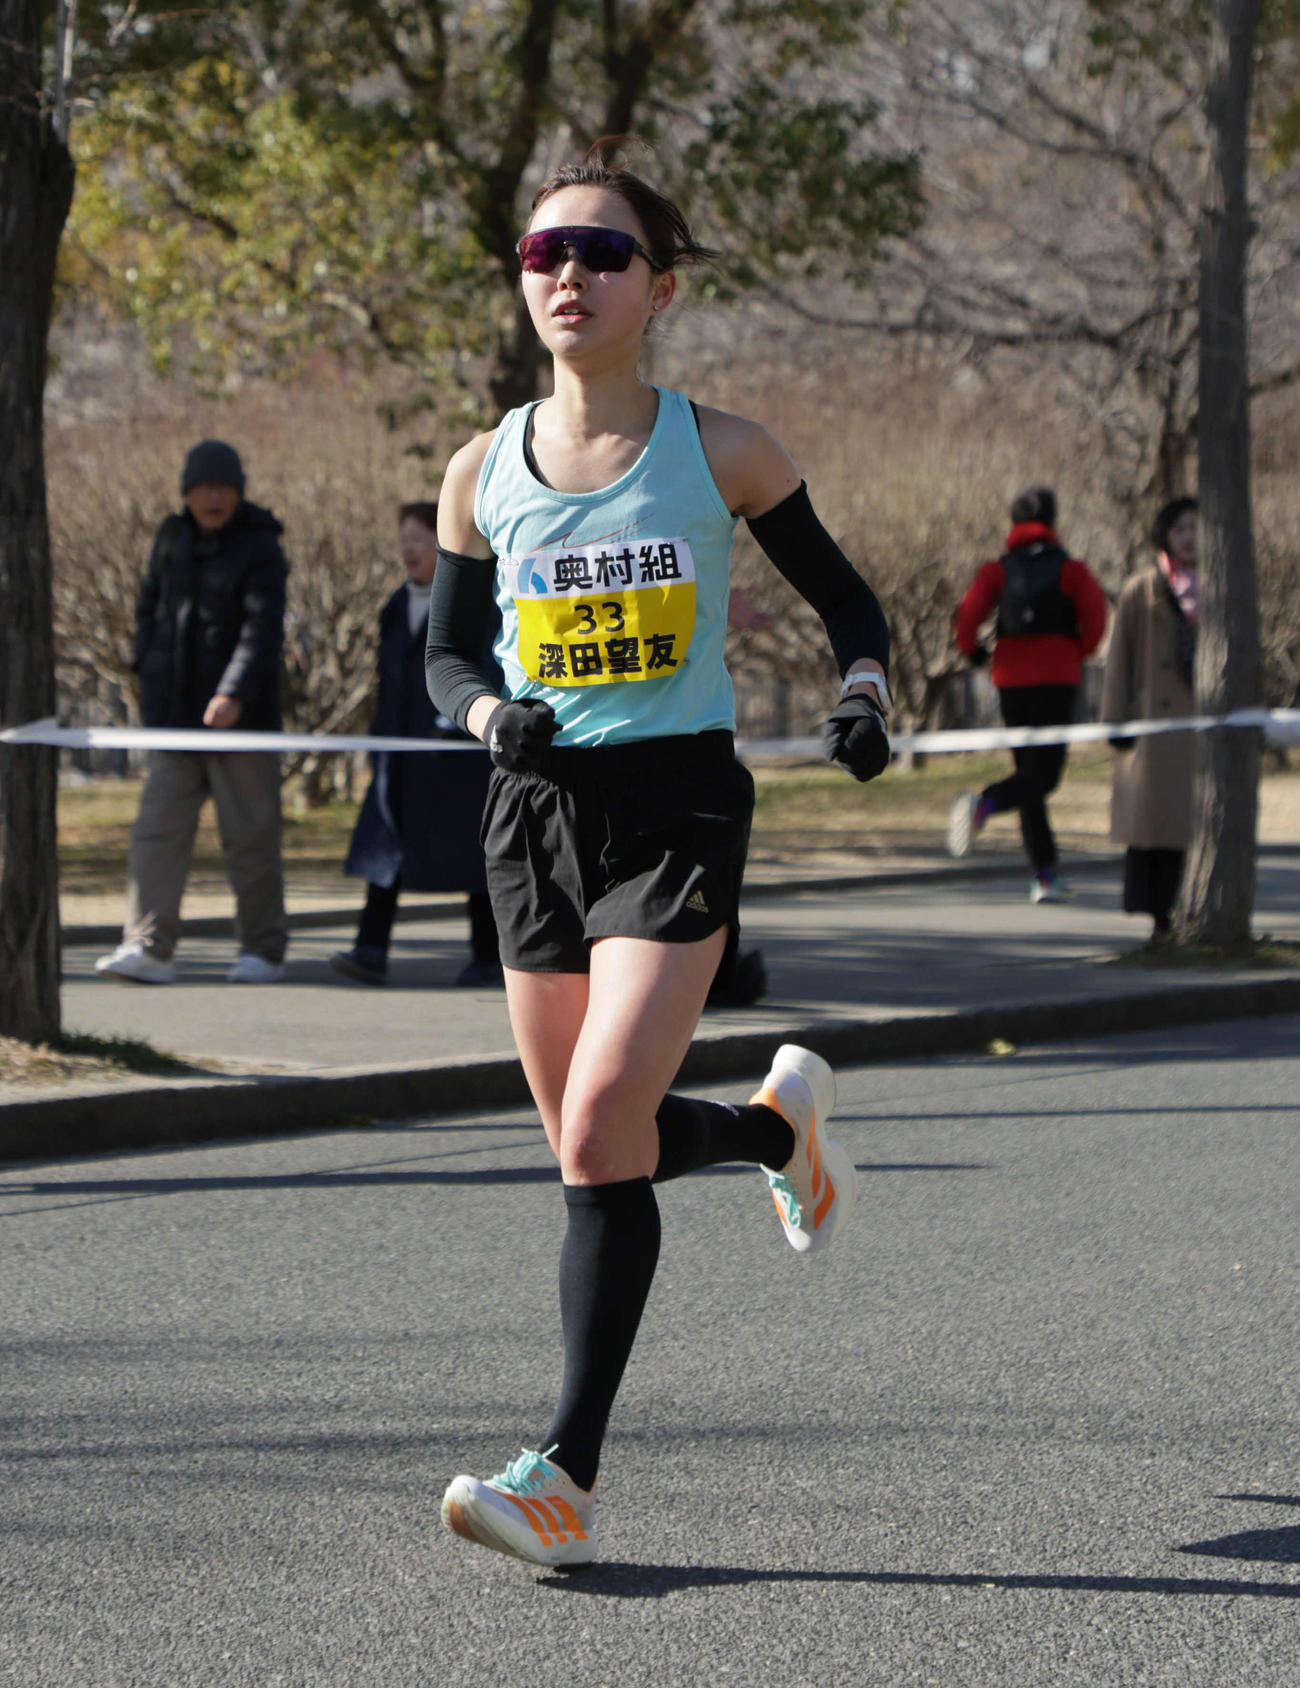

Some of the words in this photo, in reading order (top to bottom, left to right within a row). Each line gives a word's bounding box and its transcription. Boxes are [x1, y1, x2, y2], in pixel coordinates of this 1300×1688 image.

[553, 543, 682, 592] 奥村組
[574, 601, 625, 634] 33
[538, 633, 678, 679] 深田望友
